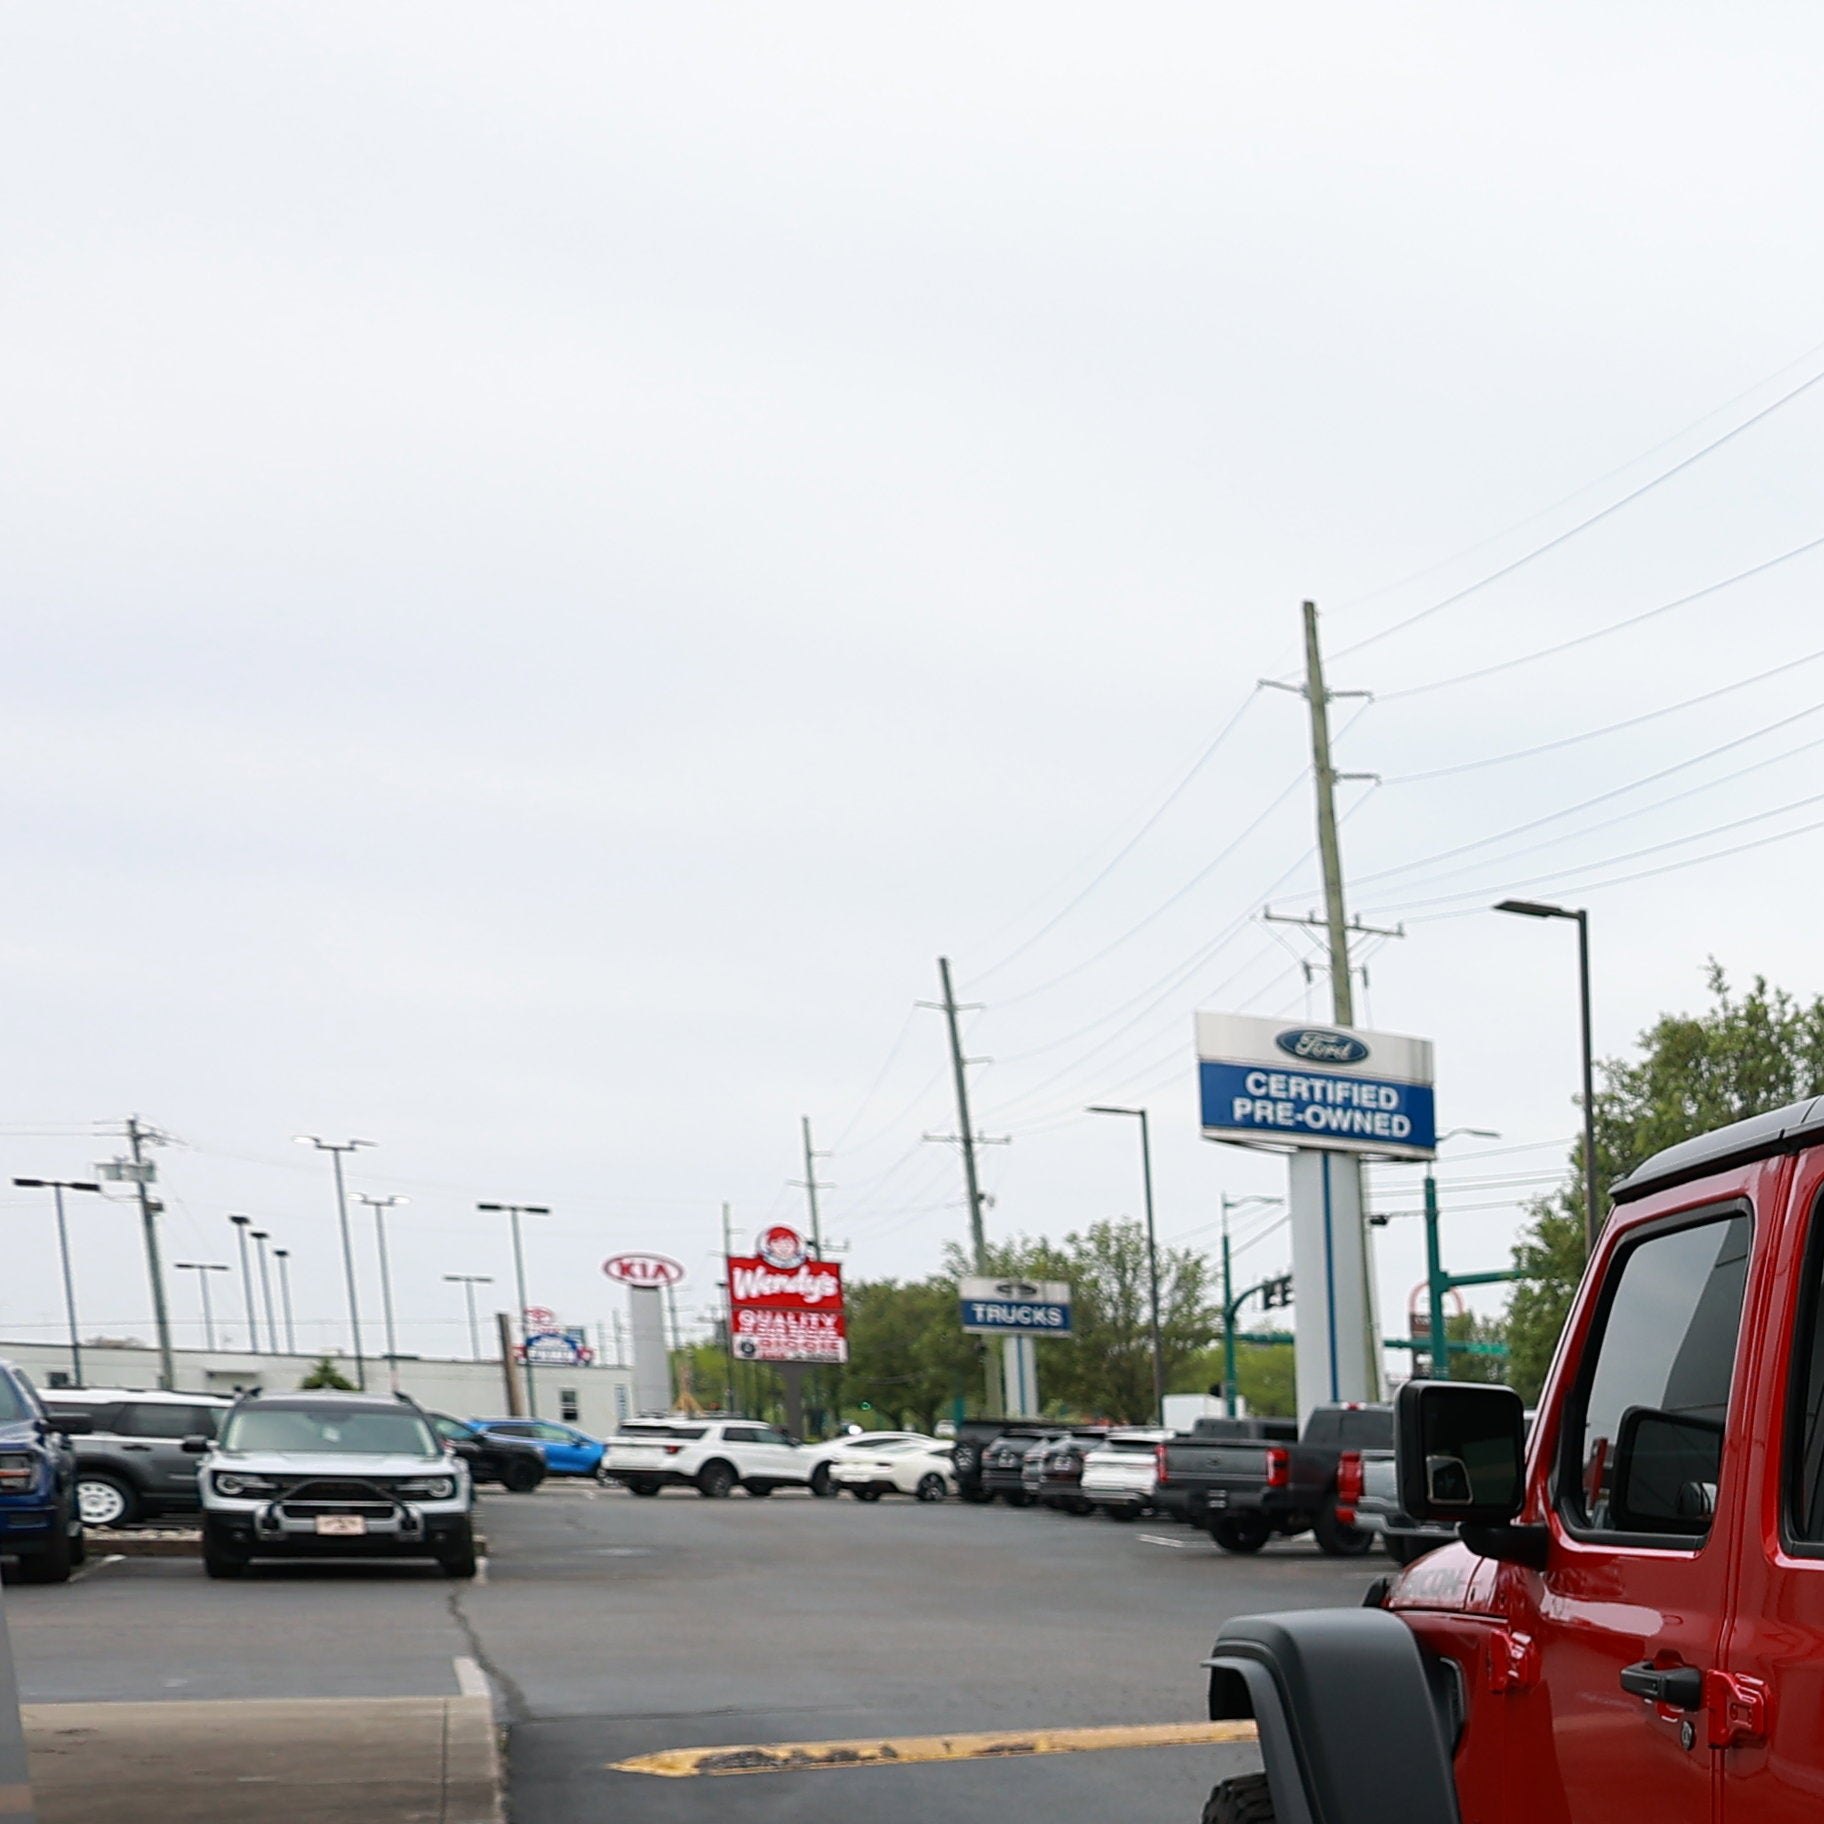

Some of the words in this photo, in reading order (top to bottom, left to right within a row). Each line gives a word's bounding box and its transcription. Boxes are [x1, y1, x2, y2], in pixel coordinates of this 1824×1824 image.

[1292, 1030, 1356, 1060] Ford
[1245, 1071, 1399, 1110] CERTIFIED
[1233, 1097, 1411, 1138] PRE-OWNED
[618, 1261, 670, 1279] KIA
[733, 1265, 838, 1304] Wendy's
[971, 1303, 1063, 1326] TRUCKS
